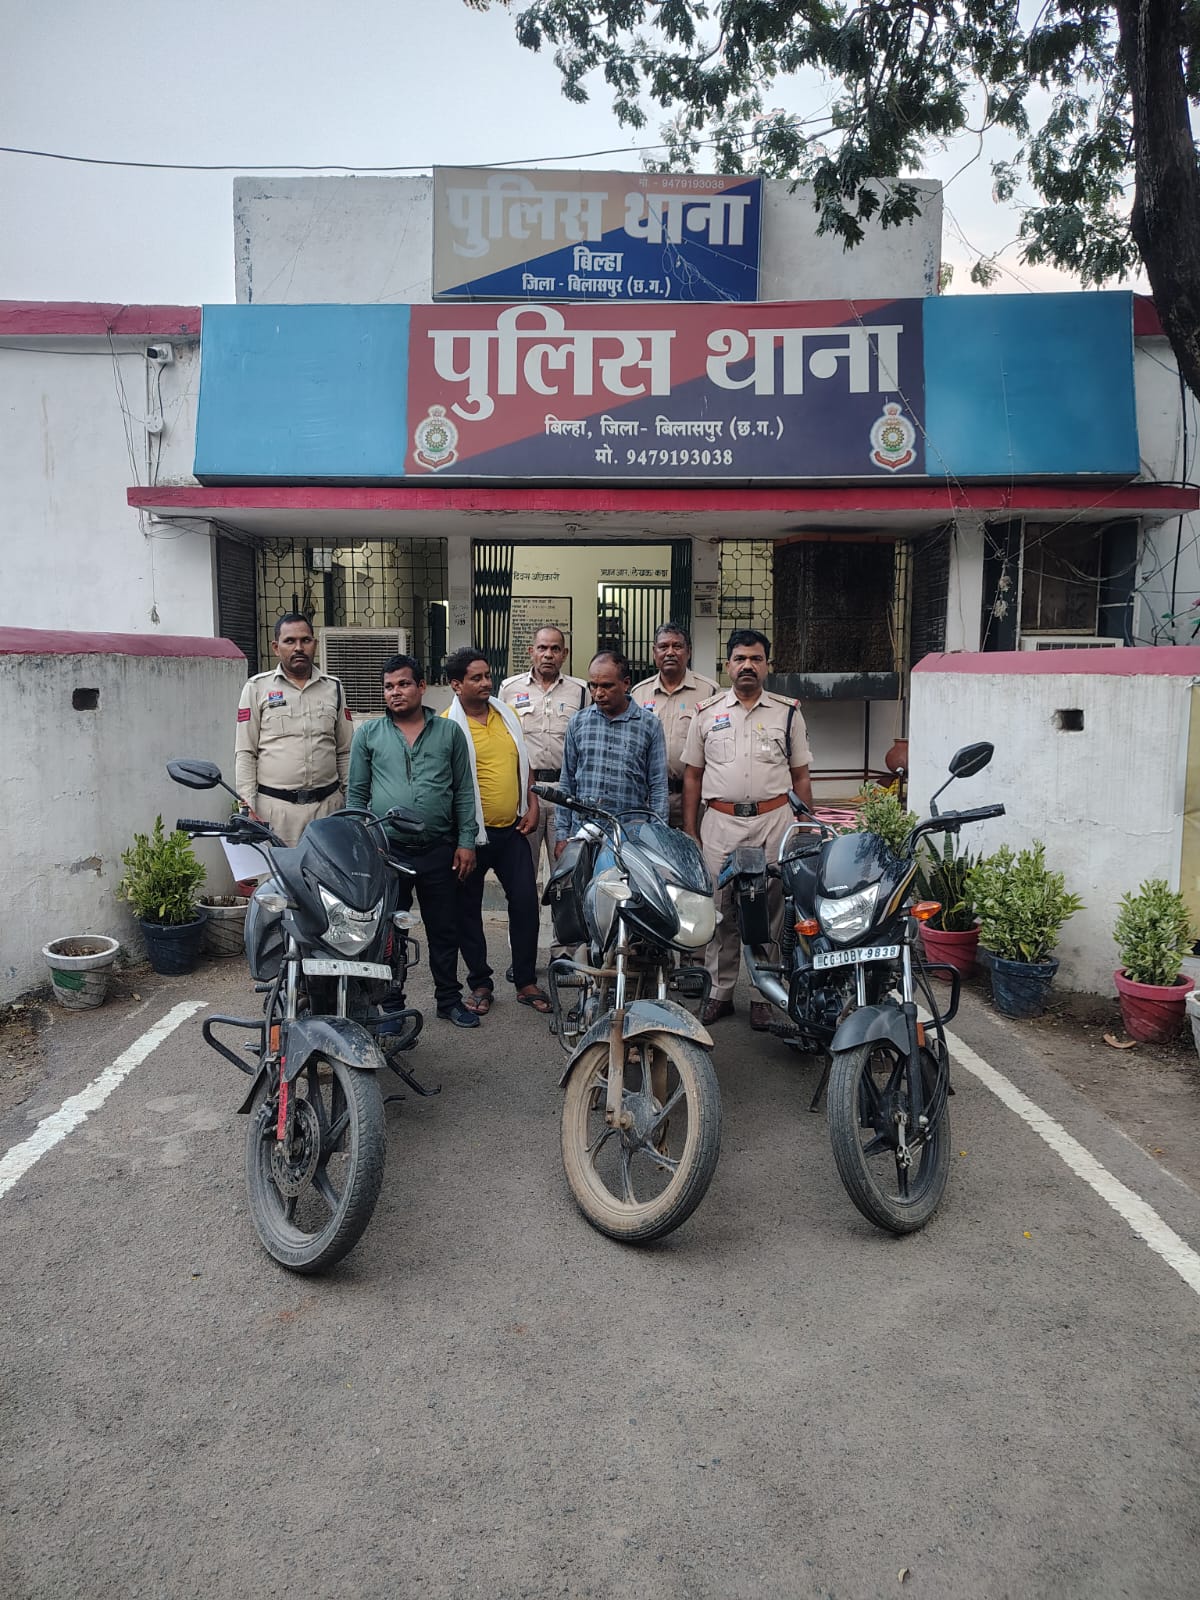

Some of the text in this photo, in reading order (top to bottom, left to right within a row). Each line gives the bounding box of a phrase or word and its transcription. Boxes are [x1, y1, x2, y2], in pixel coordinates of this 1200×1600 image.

[662, 179, 725, 189] 9479193038
[446, 174, 751, 258] पुलिस थाना
[573, 246, 624, 272] बिल्हा
[522, 273, 556, 292] जिला
[567, 276, 623, 297] बिलासपुर
[627, 276, 671, 295] (छ.ग.)
[427, 304, 903, 421] पुलिस थाना
[544, 415, 592, 439] बिल्हा,
[655, 415, 723, 443] बिलासपुर
[730, 416, 785, 440] (छ.ग.)
[593, 446, 734, 466] मो. 9479193038
